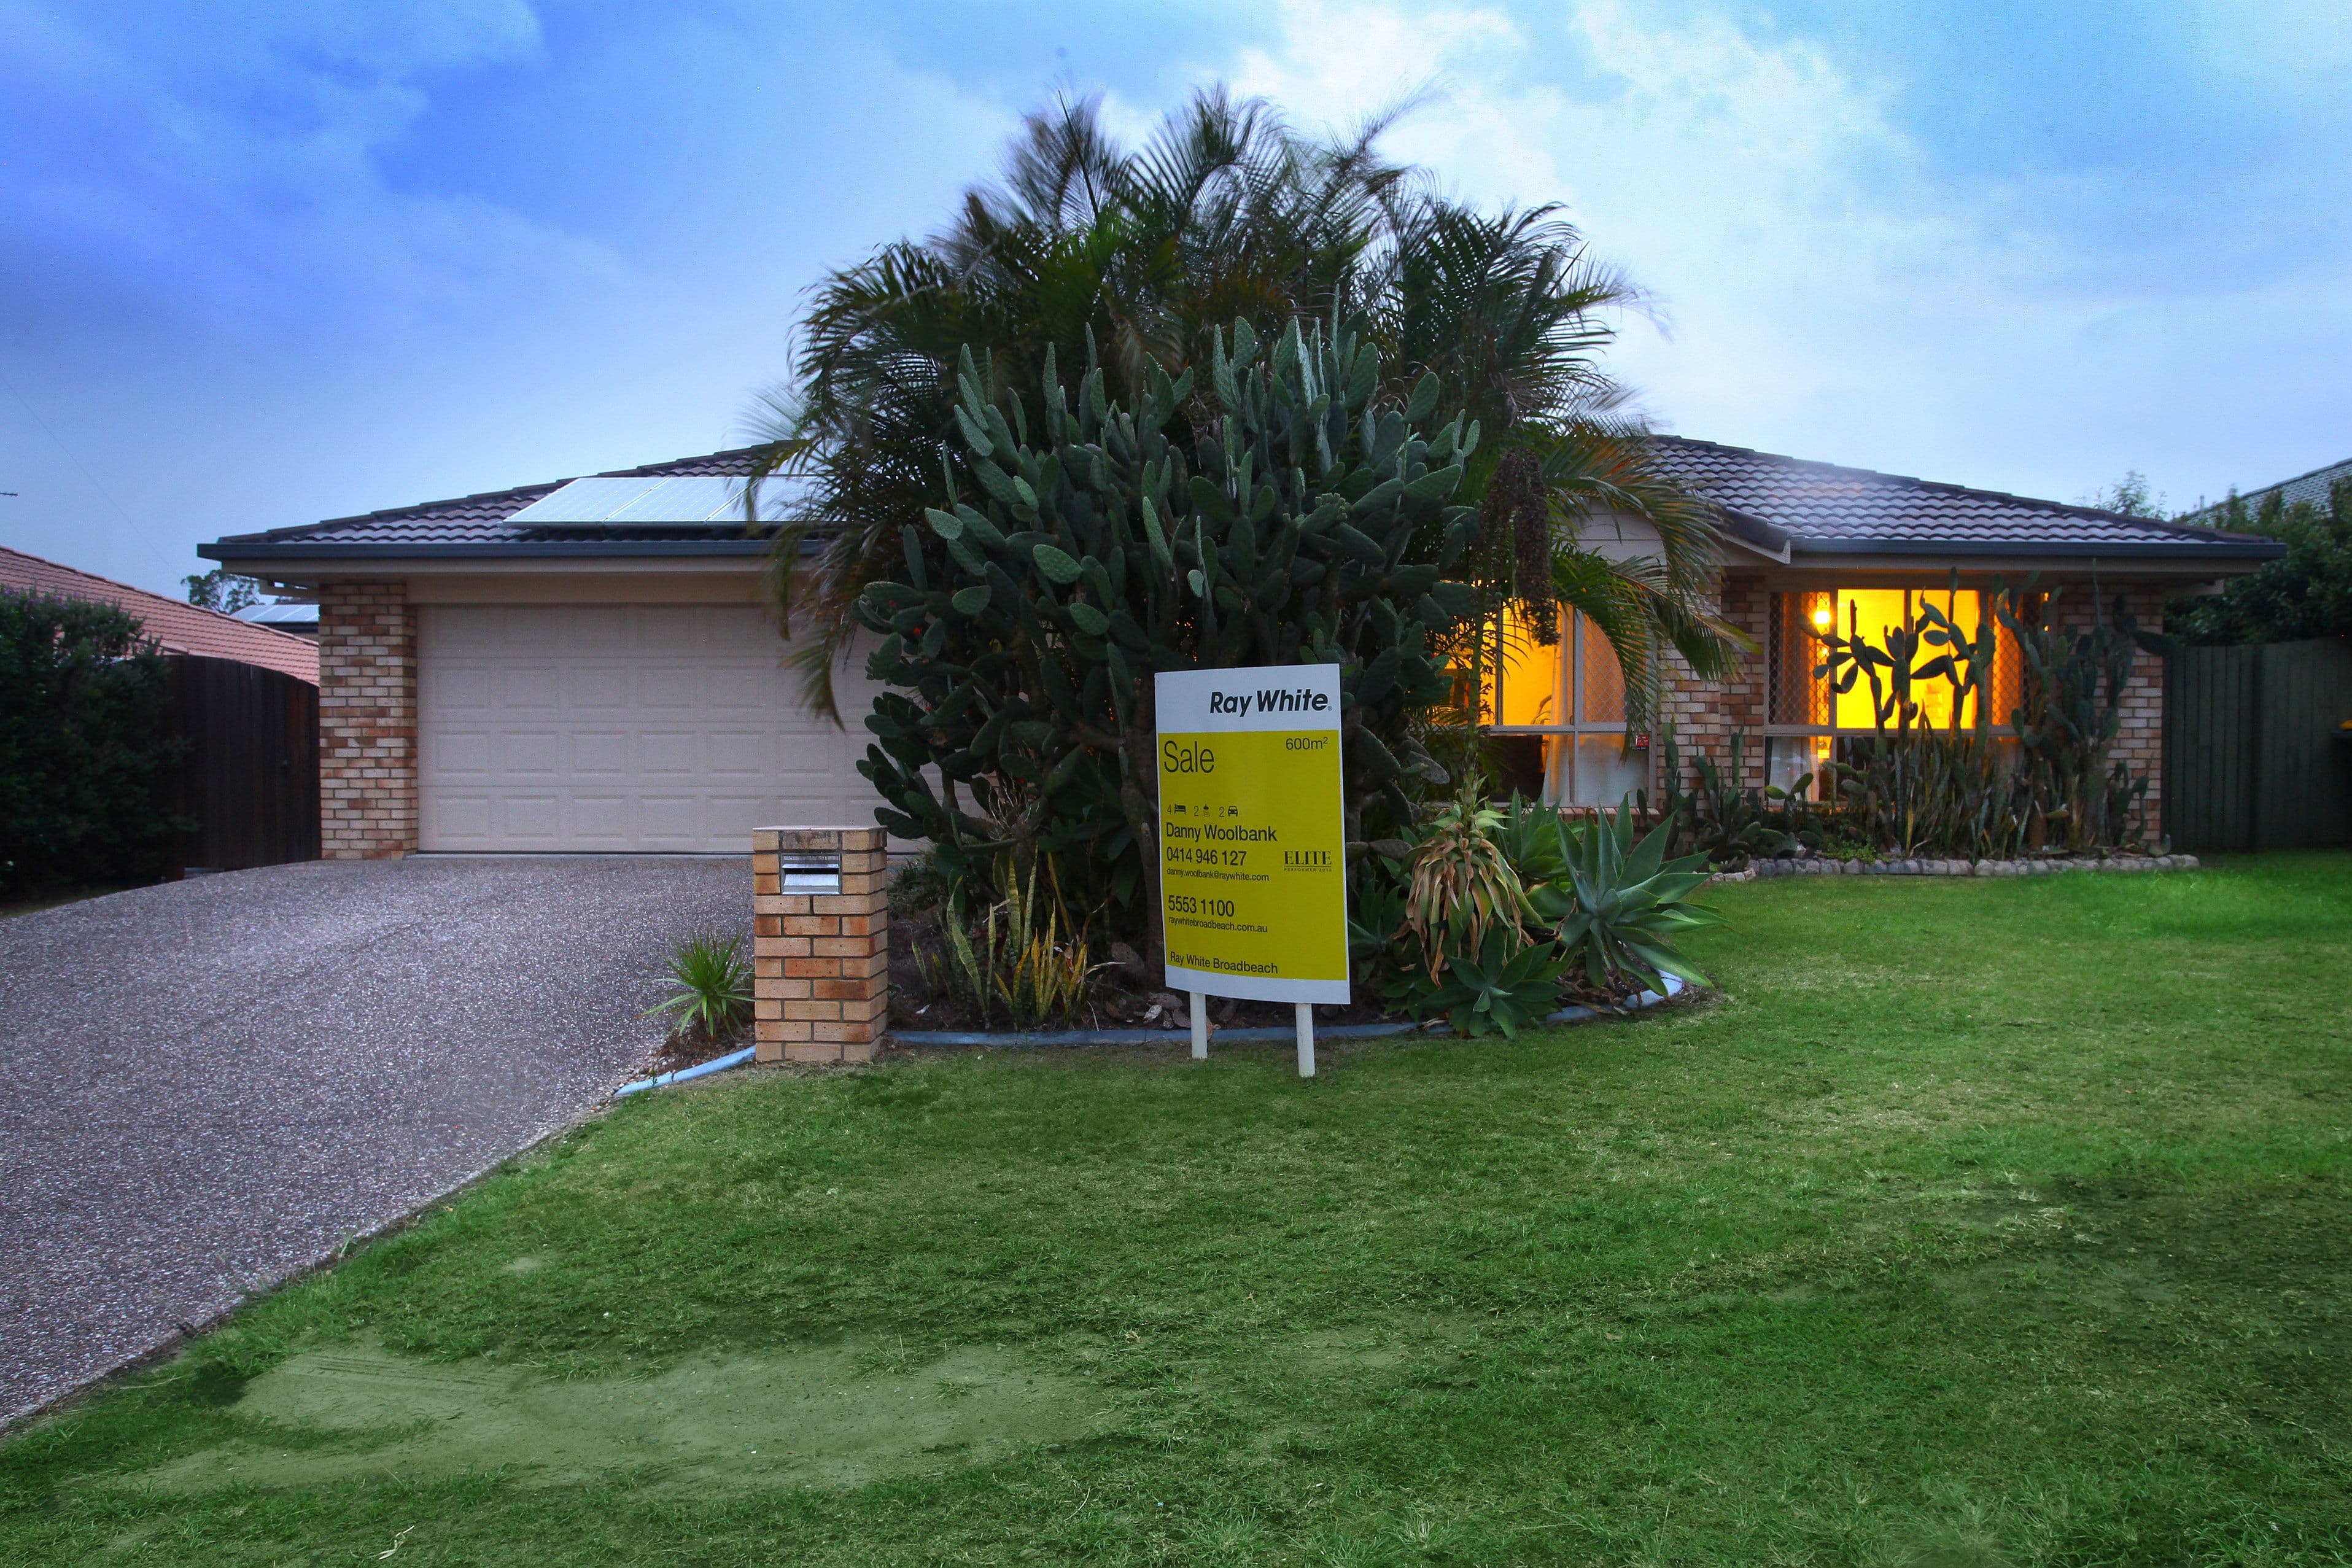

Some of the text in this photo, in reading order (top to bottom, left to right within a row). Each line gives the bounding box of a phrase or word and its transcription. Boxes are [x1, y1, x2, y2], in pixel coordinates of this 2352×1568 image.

[1209, 689, 1329, 717] Ray White
[1164, 740, 1215, 774] Sale
[1167, 804, 1225, 818] 4 2 2
[1166, 822, 1278, 842] Danny Woolbank
[1166, 846, 1248, 866] 0414 946 127
[1284, 850, 1332, 865] ELITE
[1166, 867, 1270, 882] danny.woolbank@raywhite.com
[1168, 895, 1235, 917] 5553 1100
[1168, 916, 1268, 933] raywhitebroadbeach.com.au
[1170, 952, 1278, 974] Ray White Broadbeach
